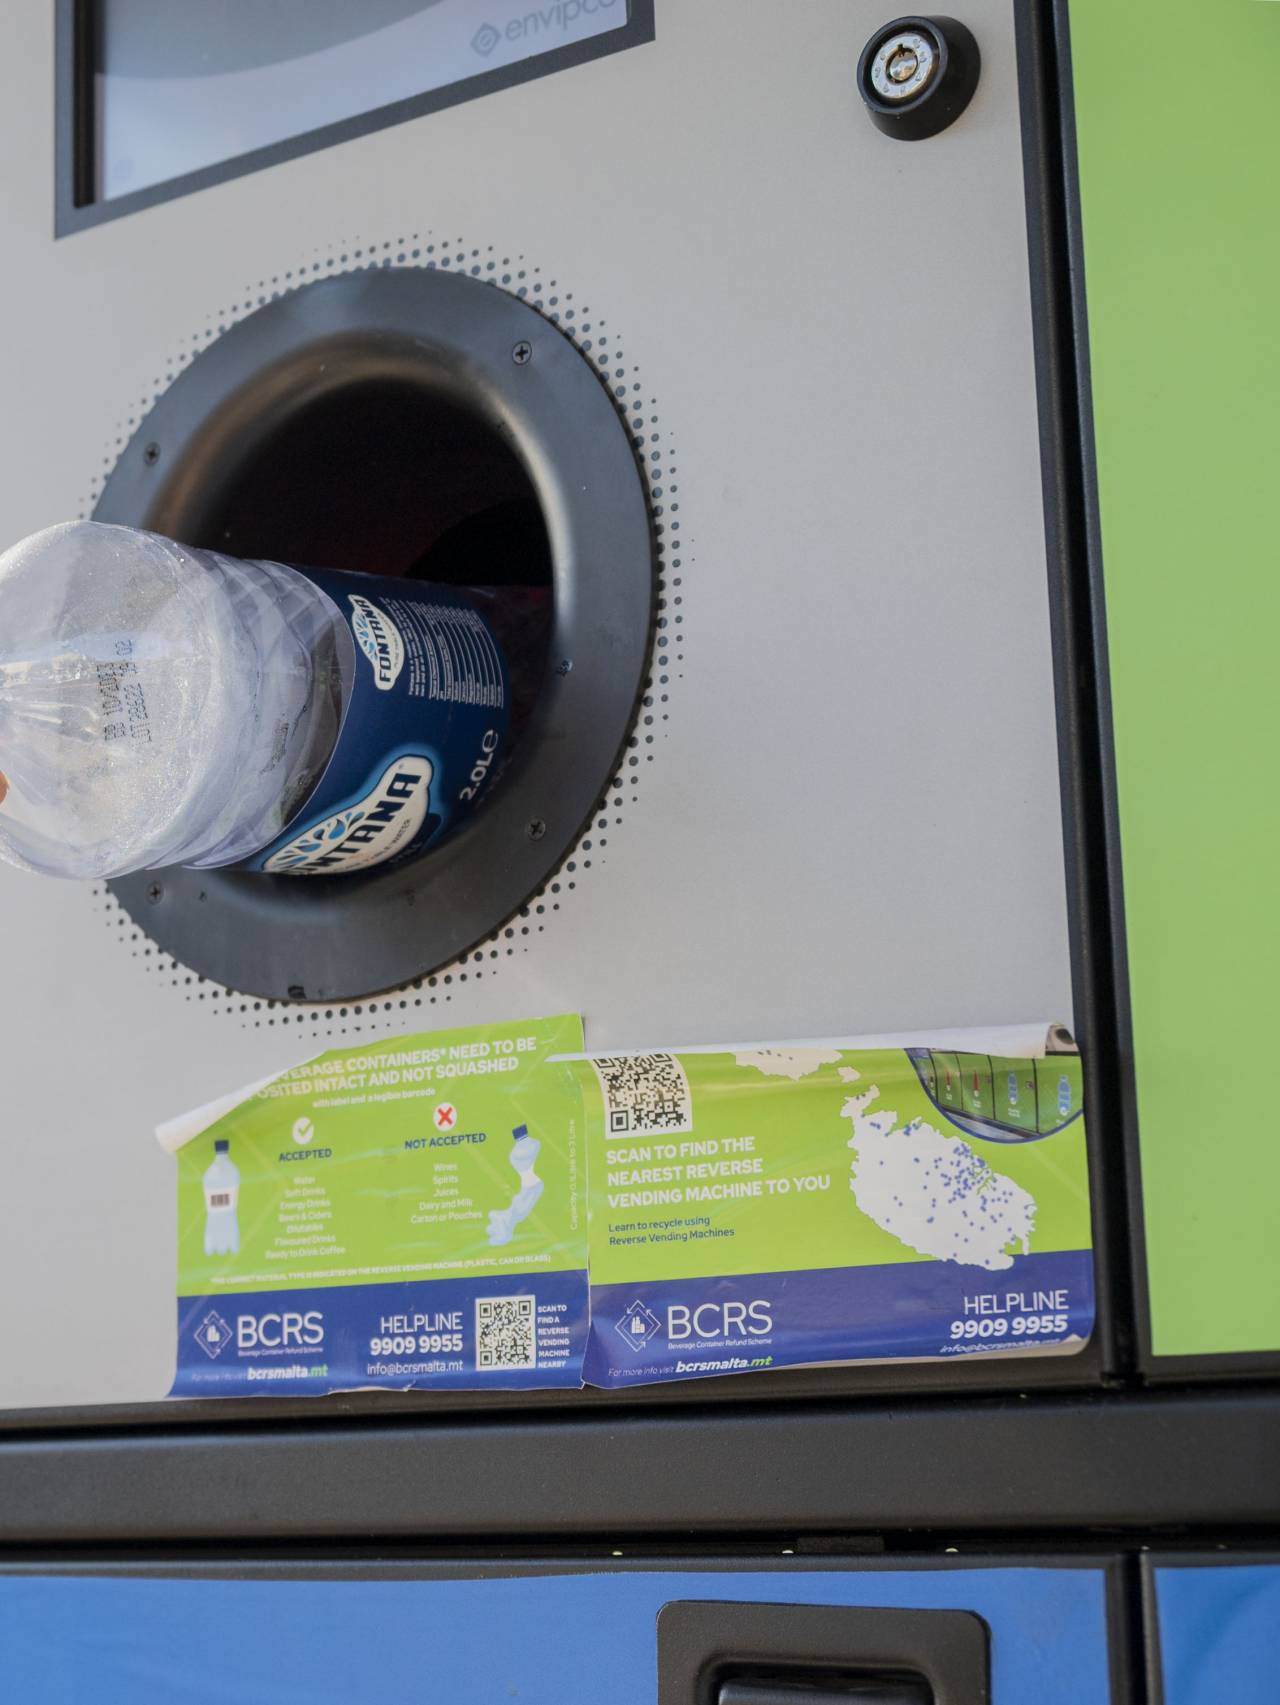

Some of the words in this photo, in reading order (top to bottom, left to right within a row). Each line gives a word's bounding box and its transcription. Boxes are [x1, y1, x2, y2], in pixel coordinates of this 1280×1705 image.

[355, 599, 391, 682] FONTANA
[292, 772, 422, 873] NTANA
[449, 1042, 490, 1060] NEED
[492, 1039, 514, 1054] TO
[516, 1037, 537, 1052] BE
[256, 1080, 313, 1099] OSITED
[314, 1074, 366, 1093] INTACT
[368, 1070, 401, 1087] AND
[402, 1066, 434, 1083] NOT
[436, 1056, 519, 1079] SQUASHED
[404, 1138, 427, 1150] NOT
[429, 1133, 487, 1147] ACCEPTED
[279, 1148, 332, 1162] ACCEPTED
[606, 1146, 651, 1165] SCAN
[653, 1144, 677, 1160] TO
[680, 1140, 719, 1158] FIND
[721, 1136, 755, 1153] THE
[608, 1166, 683, 1187] NEAREST
[686, 1158, 763, 1179] REVERSE
[608, 1189, 682, 1209] VENDING
[685, 1181, 763, 1202] MACHINE
[766, 1178, 790, 1194] TO
[793, 1175, 831, 1192] YOU
[608, 1222, 635, 1233] Learn
[637, 1221, 648, 1231] to
[648, 1218, 683, 1231] recycle
[684, 1216, 711, 1228] using
[609, 1235, 647, 1246] Reverse
[648, 1231, 688, 1244] Vending
[689, 1228, 735, 1240] Machines
[537, 1304, 556, 1313] SCAN
[557, 1304, 567, 1312] TO
[964, 1289, 1070, 1315] HELPLINE
[381, 1312, 464, 1334] HELPLINE
[537, 1316, 553, 1324] FIND
[667, 1300, 773, 1340] BCRS
[950, 1318, 1008, 1339] 9909
[1011, 1314, 1068, 1336] 9955
[237, 1311, 324, 1348] BCRS
[538, 1327, 570, 1335] REVERSE
[370, 1336, 416, 1356] 9909
[419, 1333, 464, 1354] 9955
[538, 1338, 570, 1347] VENDING
[668, 1342, 696, 1351] Beverage
[696, 1340, 725, 1349] Container
[725, 1338, 748, 1347] Refund
[538, 1349, 570, 1358] MACHINE
[247, 1364, 328, 1380] bcrsmalta.mt
[367, 1360, 464, 1376] info@bcrsmalta.mt
[538, 1360, 567, 1369] NEARBY
[608, 1368, 620, 1377] For
[622, 1368, 643, 1376] more
[676, 1356, 773, 1373] bcrsmalta.mt
